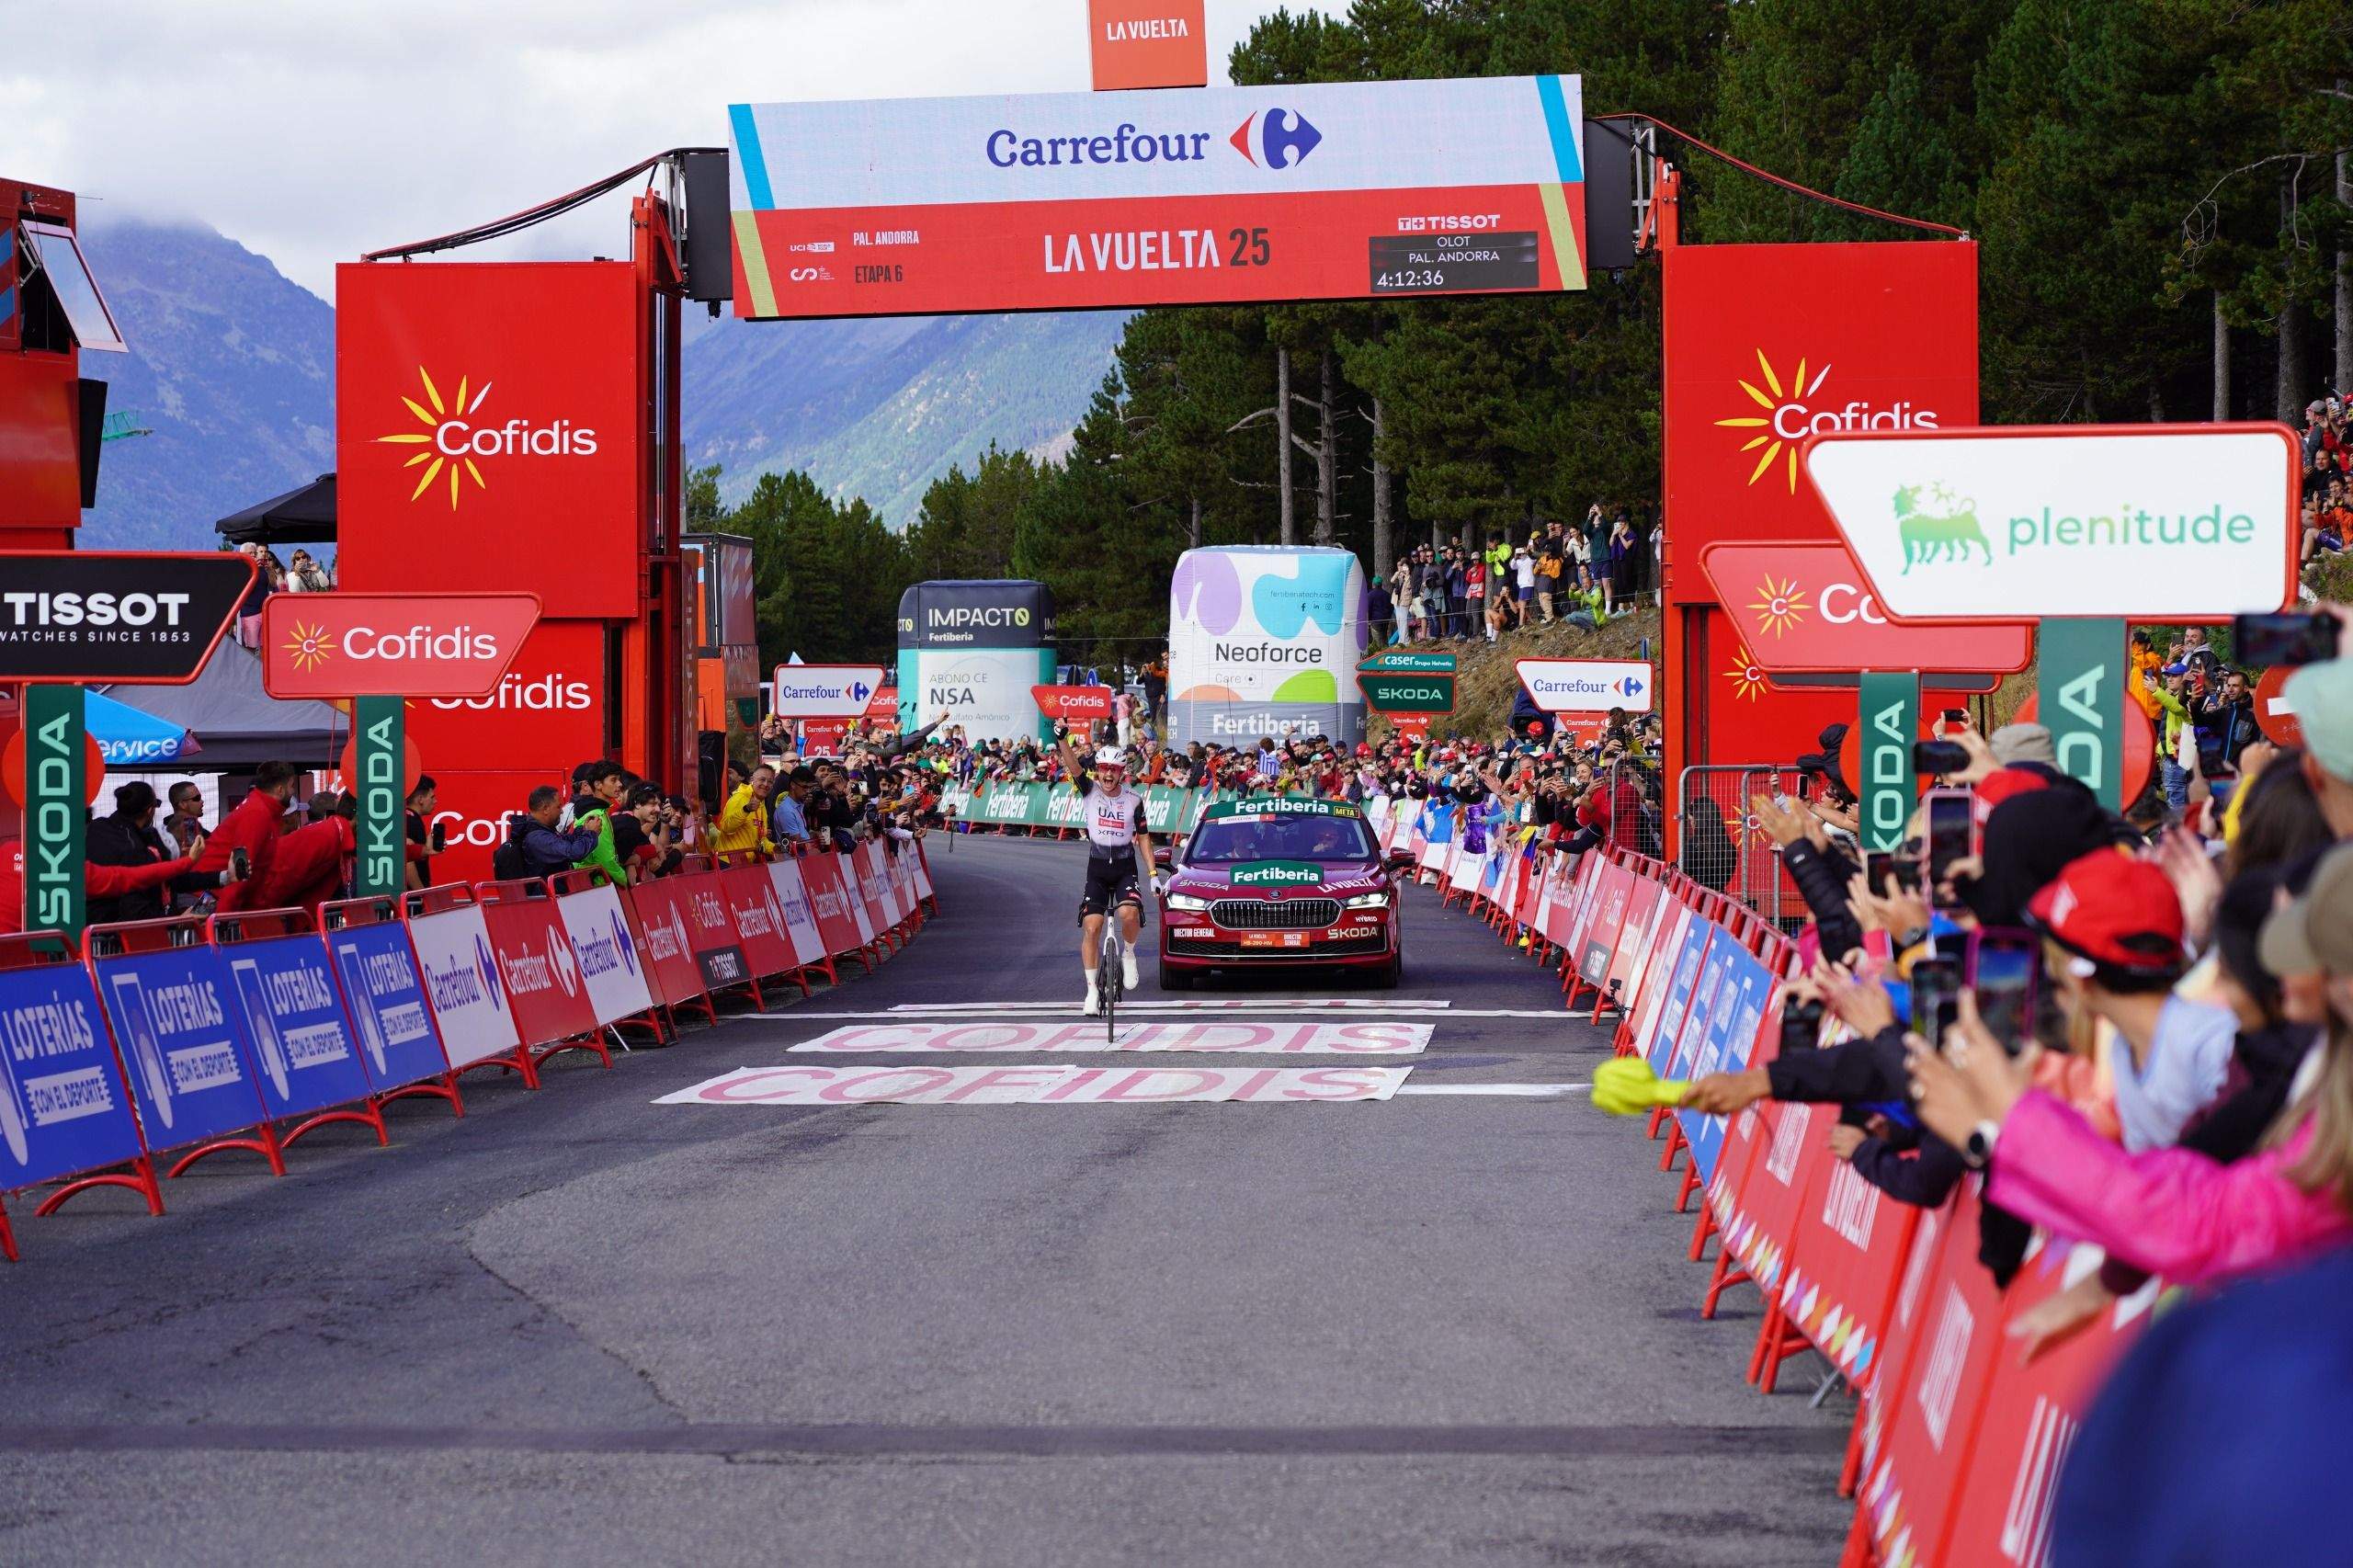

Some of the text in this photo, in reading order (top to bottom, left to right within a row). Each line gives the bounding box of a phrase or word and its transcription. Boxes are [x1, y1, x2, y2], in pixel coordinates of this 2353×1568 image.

[1108, 18, 1188, 40] LA VUELTA
[986, 123, 1211, 168] Carrefour
[1427, 214, 1501, 230] TISSOT
[875, 230, 920, 245] ANDORRA
[1437, 235, 1472, 247] OLOT
[1044, 228, 1270, 272] LA VUELTA 25
[1409, 251, 1500, 264] PAL. ANDORRA
[855, 265, 892, 283] ETAPA
[895, 265, 903, 282] 6
[1377, 269, 1444, 287] 4:12:36
[1774, 402, 1939, 439] Cofidis
[437, 419, 597, 456] Cofidis
[2009, 504, 2256, 556] plenitude
[4, 592, 190, 626] TISSOT
[0, 631, 191, 642] WATCHES SINCE 1853
[343, 625, 498, 660] Cofidis
[928, 631, 974, 642] Fertiberia
[1215, 642, 1323, 664] Neoforce
[1384, 655, 1415, 665] caser
[929, 673, 988, 684] ABONO CE
[1215, 673, 1242, 684] Care
[1533, 678, 1608, 693] Carrefour
[430, 674, 592, 710] fidis
[783, 685, 841, 699] Carrefour
[929, 688, 975, 706] NSA
[1059, 695, 1105, 708] Cofidis
[806, 725, 832, 733] Carrefour
[96, 737, 178, 757] ervice
[984, 786, 1029, 820] Fertiberia
[1234, 798, 1329, 814] Fertiberia
[1097, 806, 1125, 821] UAE
[1335, 808, 1355, 817] META
[1097, 829, 1125, 837] XRG
[1234, 867, 1319, 883] Fertiberia
[1173, 927, 1216, 937] DIRECTOR GENERAL
[571, 926, 619, 980] Carrefour
[499, 942, 552, 995] Carrefour
[266, 958, 333, 1017] LOTERÍAS
[424, 953, 482, 1014] Carrefour
[148, 971, 224, 1036] LOTERÍAS
[3, 990, 94, 1062] LOTERÍAS
[823, 1025, 1416, 1051] COFIDIS
[698, 1068, 1392, 1101] COFIDIS
[34, 1077, 105, 1114] CON EL DEPORTE
